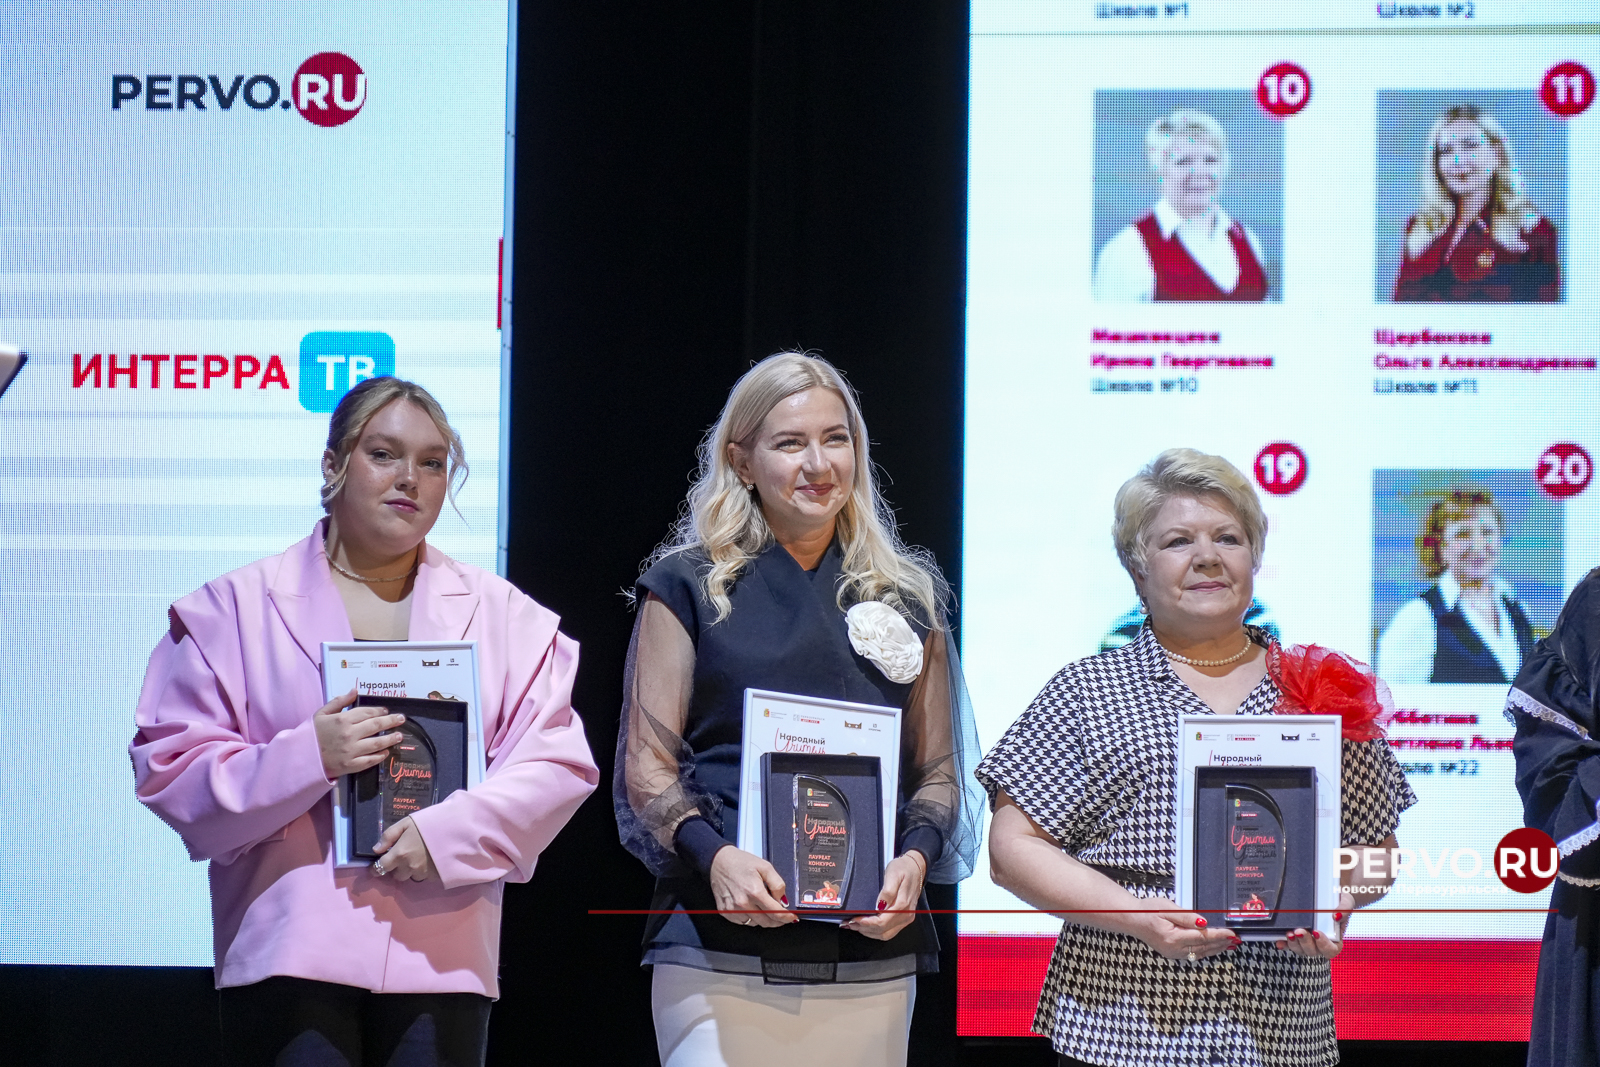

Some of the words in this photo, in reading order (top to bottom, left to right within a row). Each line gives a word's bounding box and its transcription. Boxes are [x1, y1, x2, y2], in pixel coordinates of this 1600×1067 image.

[111, 73, 366, 111] PERVO.RU
[1262, 73, 1304, 106] 10
[1552, 74, 1584, 106] 11
[72, 353, 291, 390] ИНТЕРРА
[1259, 452, 1300, 485] 19
[1541, 453, 1591, 486] 20
[359, 681, 406, 691] Народный
[779, 732, 826, 746] Народный
[1213, 754, 1262, 764] Народный
